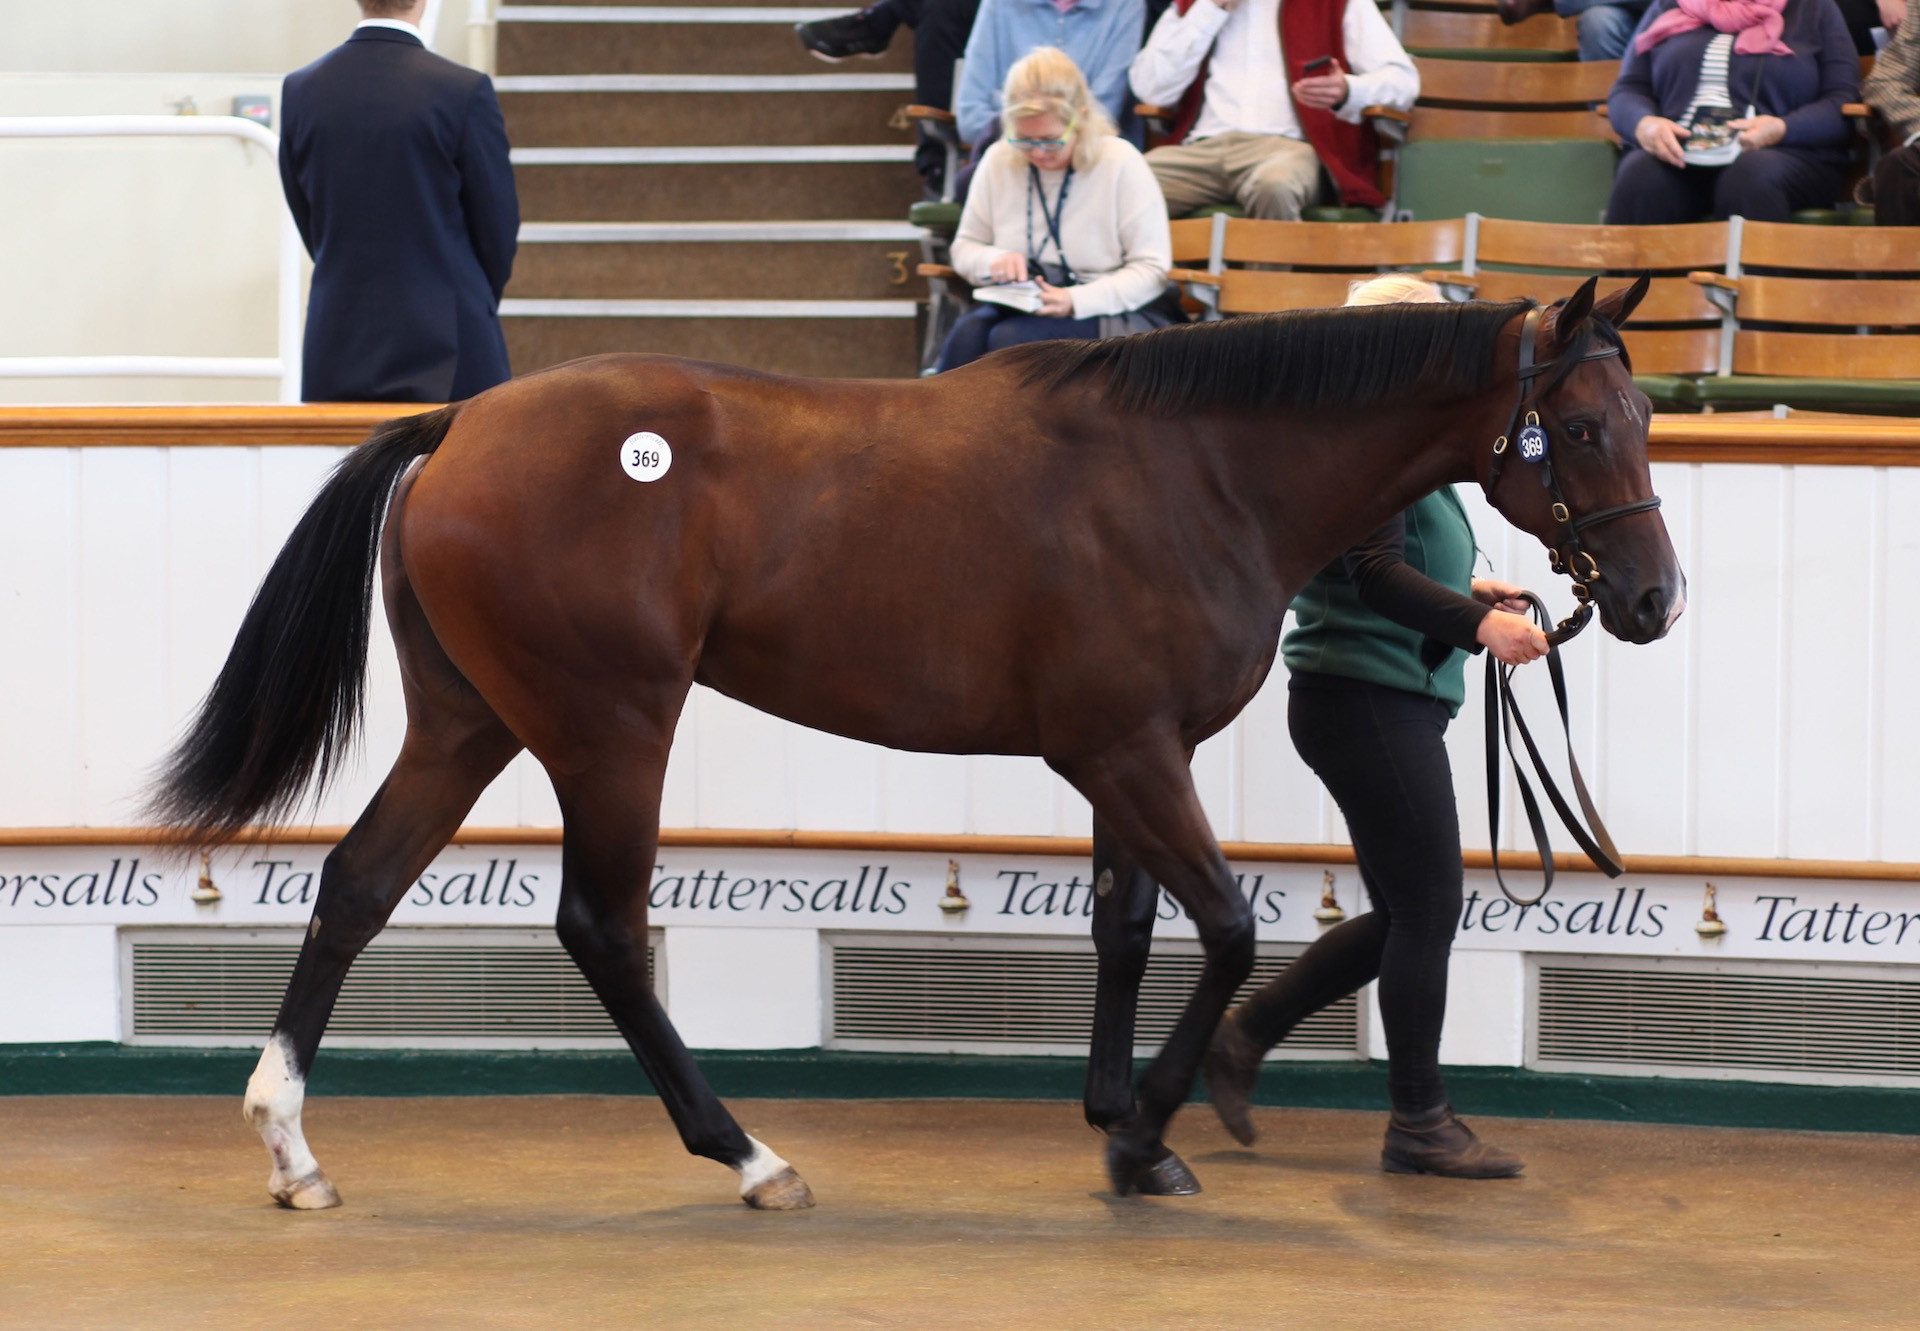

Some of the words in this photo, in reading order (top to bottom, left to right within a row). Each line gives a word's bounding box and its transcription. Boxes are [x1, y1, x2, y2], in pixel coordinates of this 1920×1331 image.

[886, 251, 909, 284] 3
[632, 449, 660, 468] 369
[1521, 436, 1543, 458] 369
[0, 858, 163, 907] rsalls
[648, 865, 911, 915] attersalls
[1461, 887, 1669, 938] tersalls
[1755, 895, 1920, 946] Tatter
